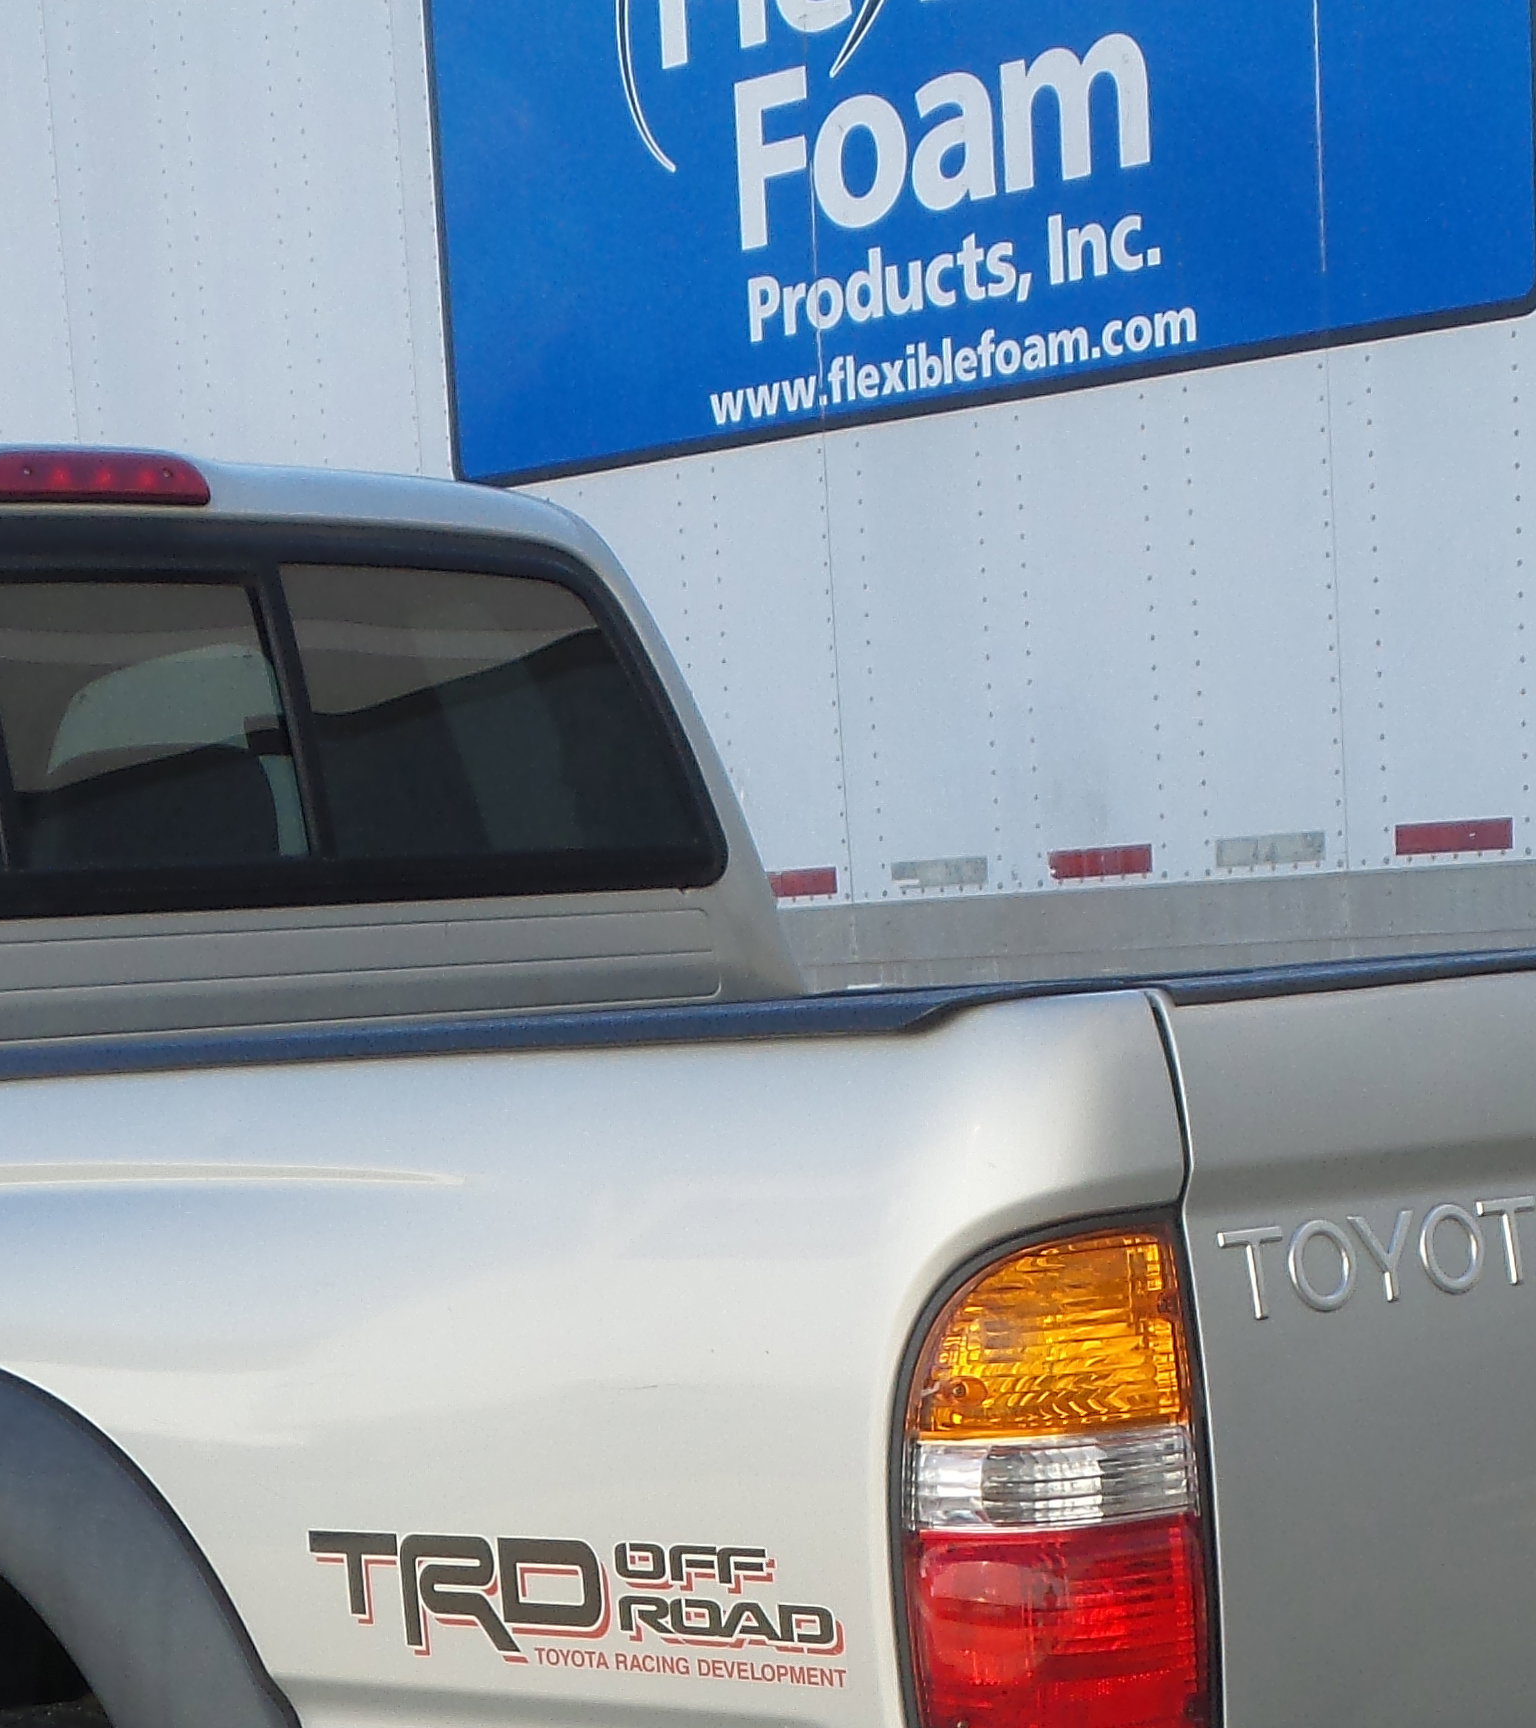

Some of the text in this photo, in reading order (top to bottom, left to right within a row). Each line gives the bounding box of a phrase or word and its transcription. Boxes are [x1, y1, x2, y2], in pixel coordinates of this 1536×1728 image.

[733, 33, 1151, 251] Foam
[748, 211, 1161, 342] Products, Inc.
[710, 305, 1197, 425] www.flexiblefoam.com
[308, 1529, 611, 1664] TRD
[614, 1541, 776, 1594] OFF
[618, 1595, 846, 1656] ROAD
[534, 1647, 847, 1689] TOYOTA RACING DEVELOPMENT
